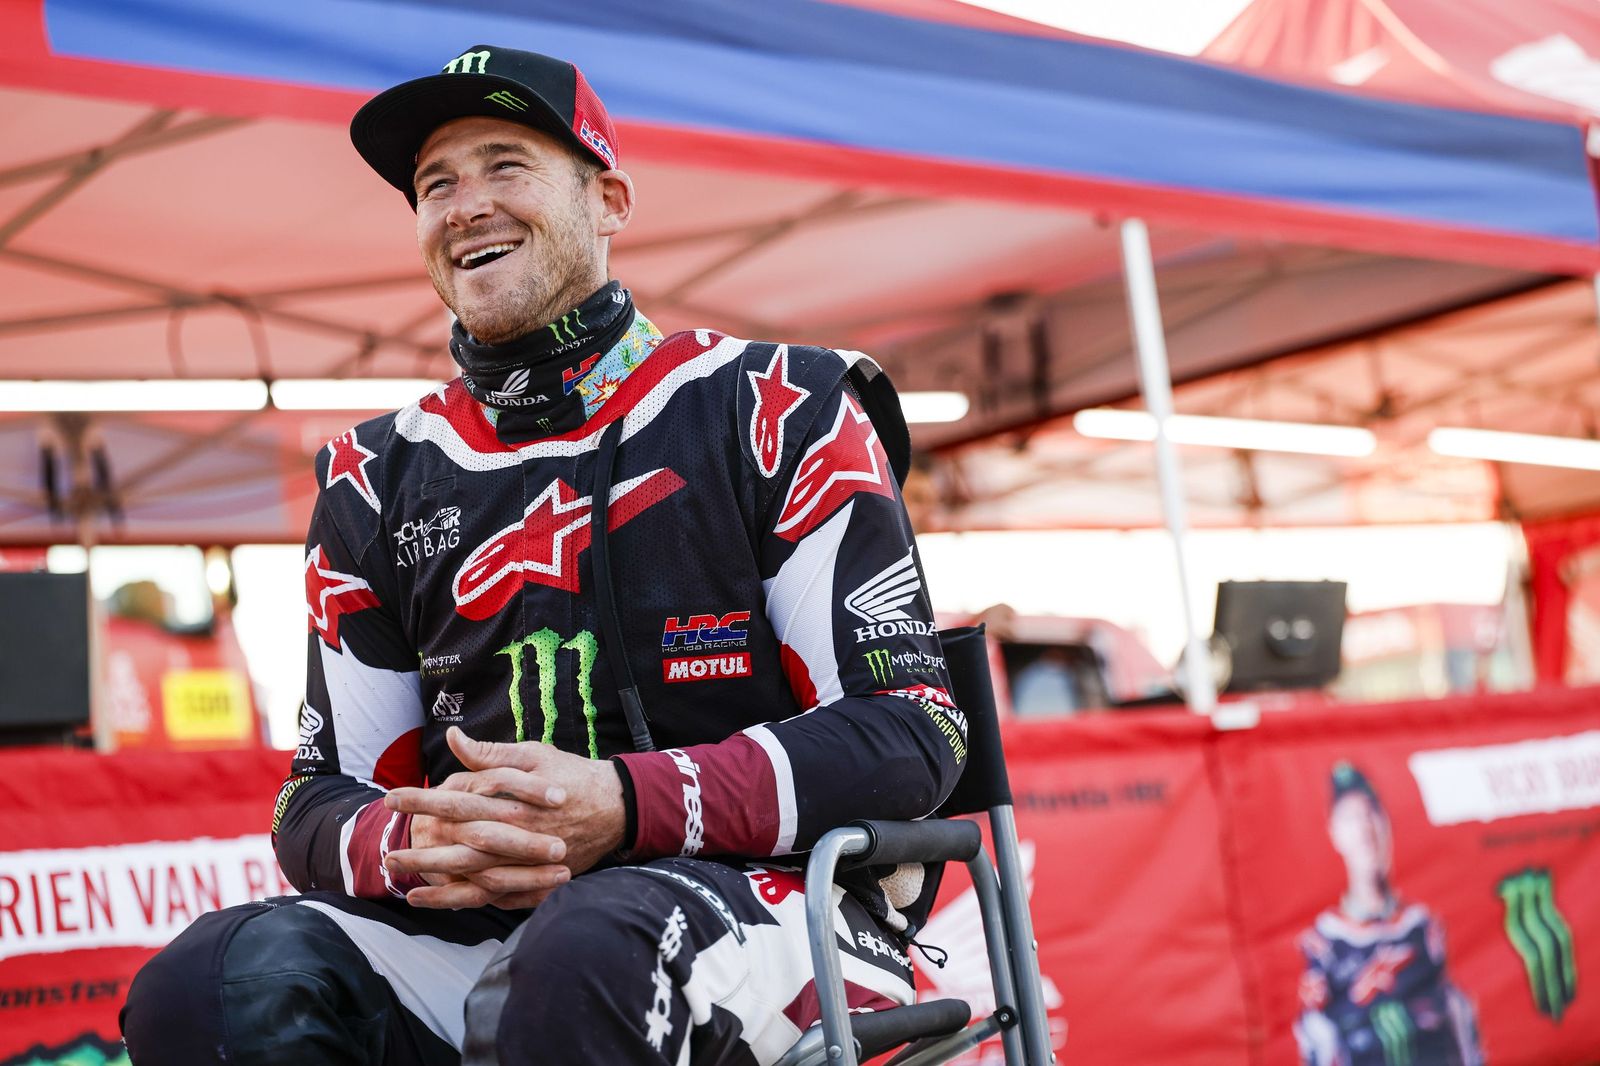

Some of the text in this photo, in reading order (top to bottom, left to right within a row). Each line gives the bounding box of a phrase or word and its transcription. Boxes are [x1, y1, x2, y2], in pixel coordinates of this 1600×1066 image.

[485, 394, 550, 407] HONDA
[662, 610, 751, 647] HRC
[853, 620, 938, 643] HONDA
[668, 656, 748, 680] MOTUL
[892, 650, 946, 670] MONSTER
[129, 863, 225, 928] VAN
